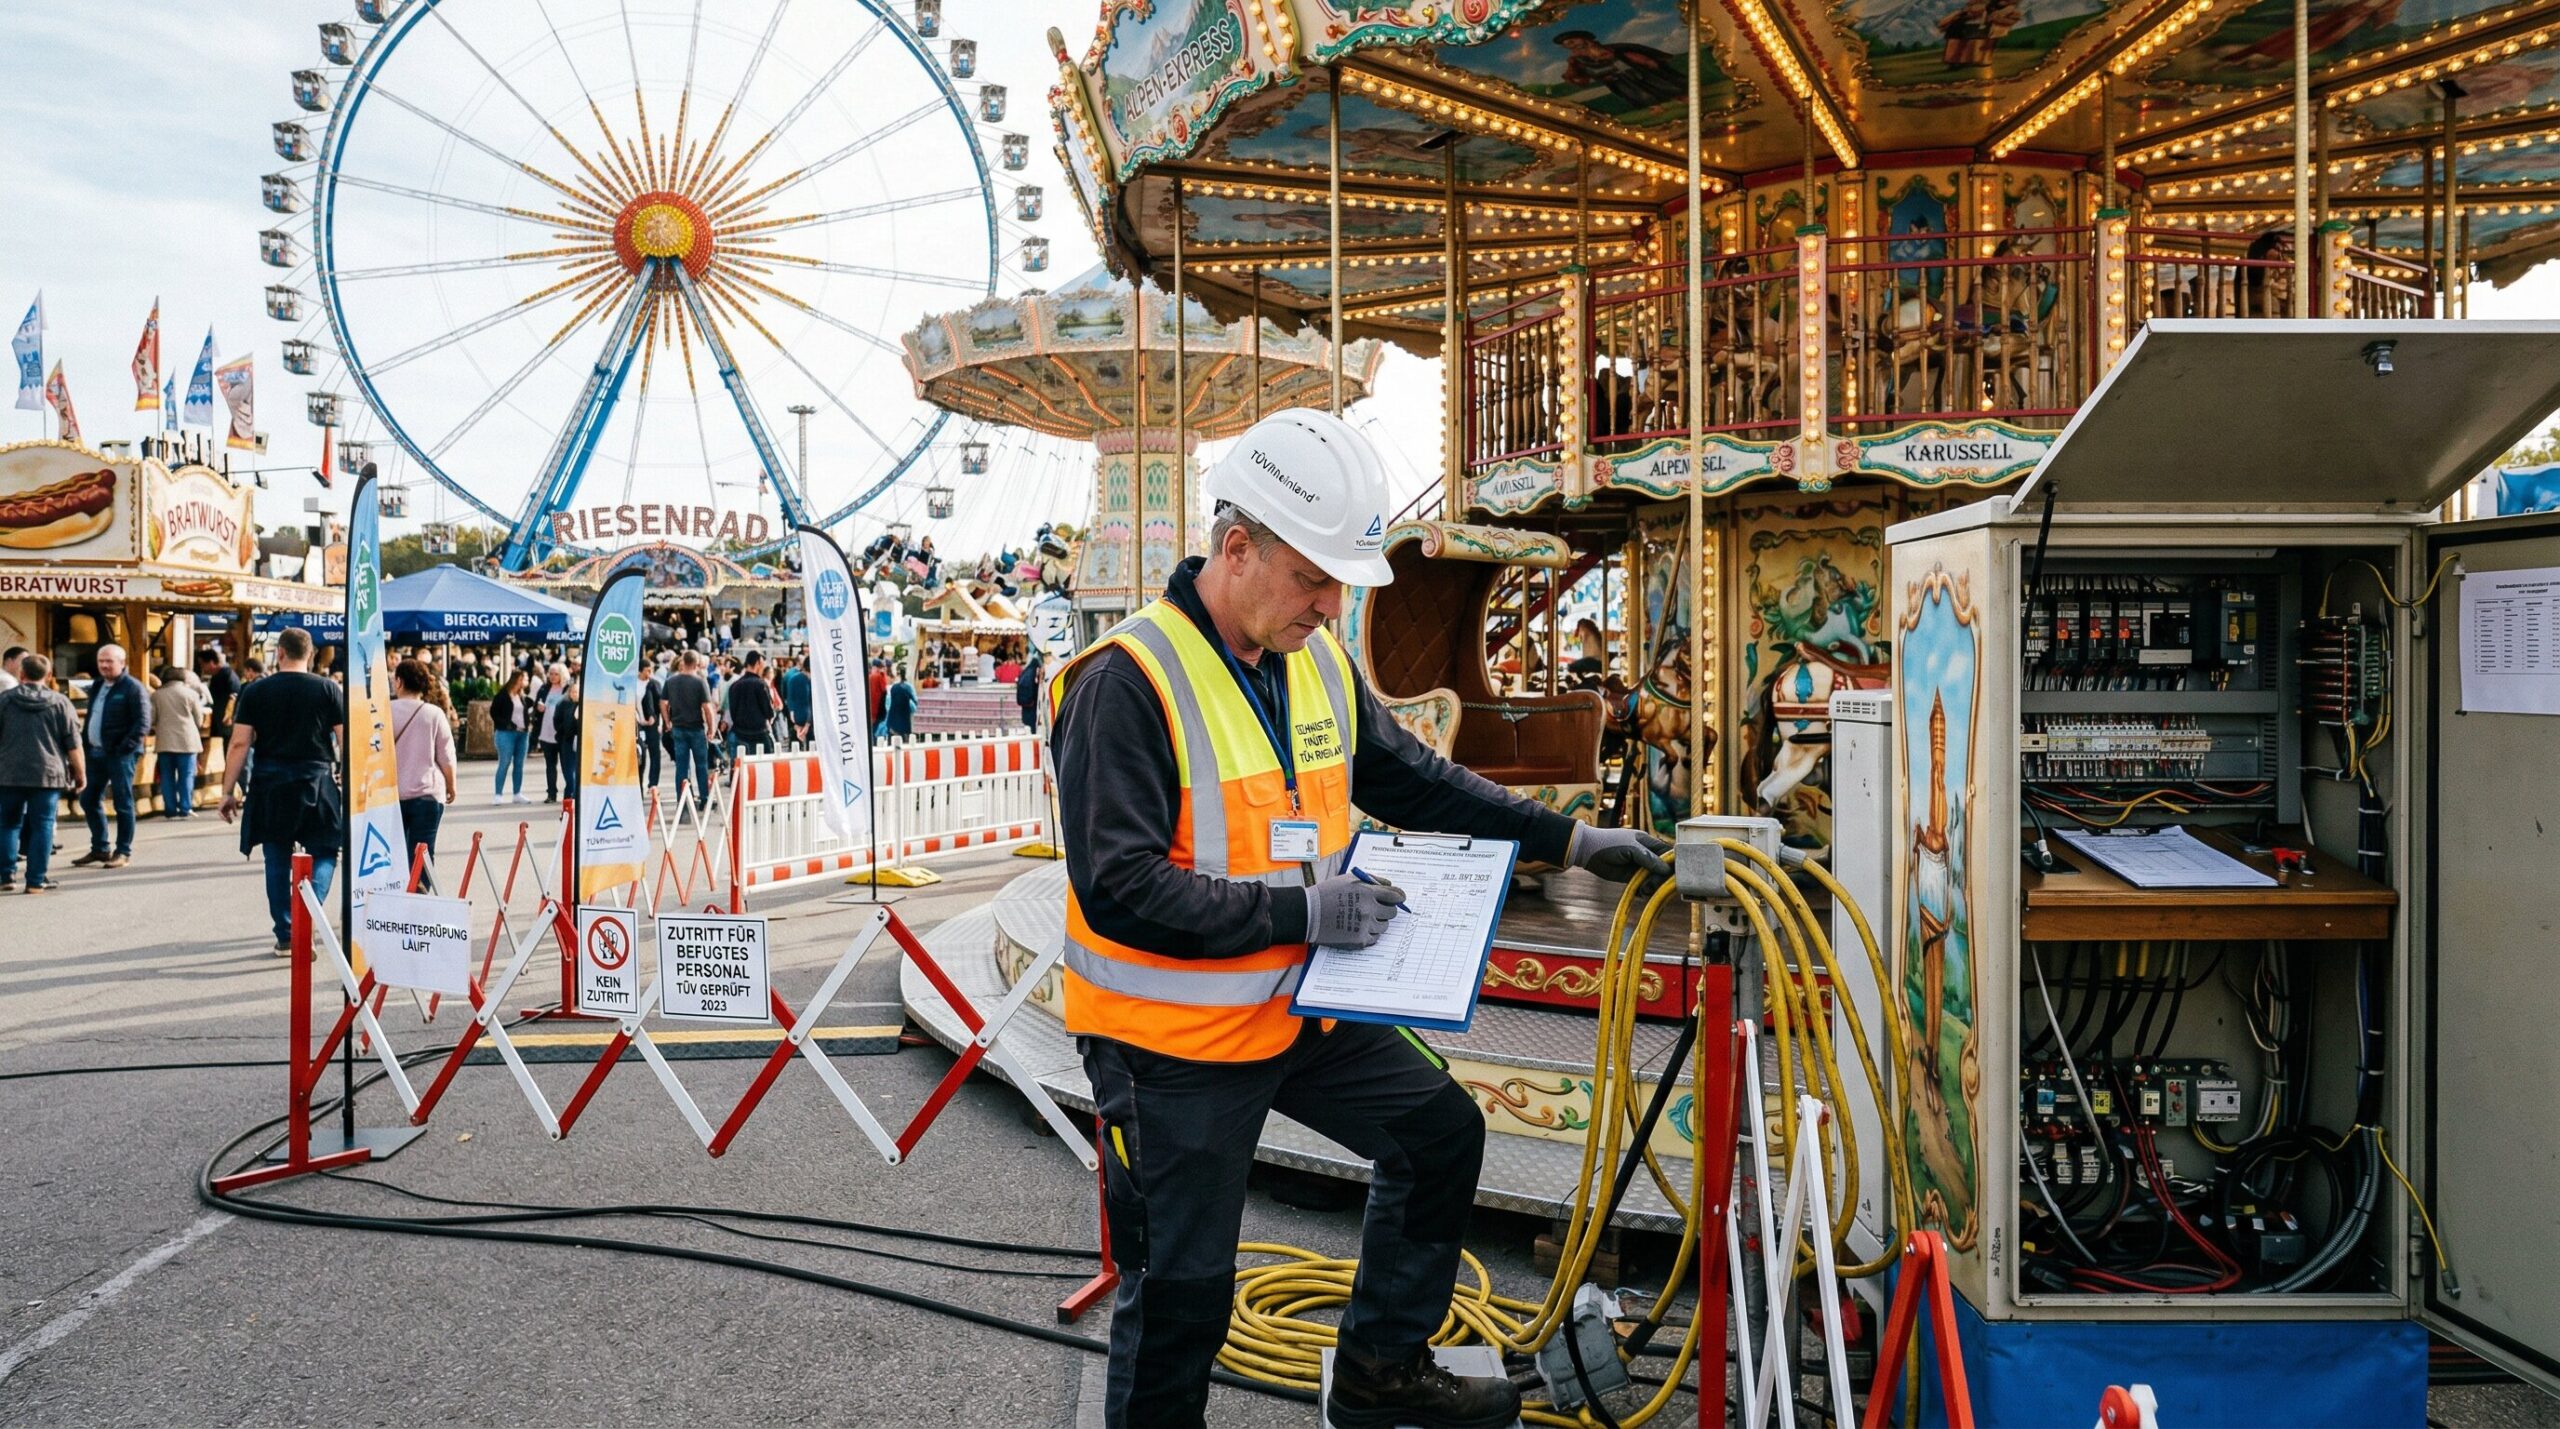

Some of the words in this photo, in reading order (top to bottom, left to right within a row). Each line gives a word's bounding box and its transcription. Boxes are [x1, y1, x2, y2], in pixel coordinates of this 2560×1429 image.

[1905, 443, 2013, 461] KARUSSELL
[167, 502, 238, 547] BRATWURST
[552, 503, 769, 546] RIESENRAD
[0, 576, 128, 594] BRATWURST
[444, 613, 538, 627] BIERGARTEN
[599, 629, 634, 645] SAFETY
[602, 645, 629, 661] FIRST
[668, 926, 723, 941] ZUTRITT
[728, 925, 756, 942] FÜR
[677, 945, 749, 960] BEFUGTES
[677, 963, 750, 979] PERSONAL
[596, 976, 621, 988] KEIN
[676, 980, 697, 995] TÜV
[700, 982, 751, 997] GEPRÜFT
[587, 989, 629, 1004] ZUTRITT
[701, 999, 727, 1012] 2023
